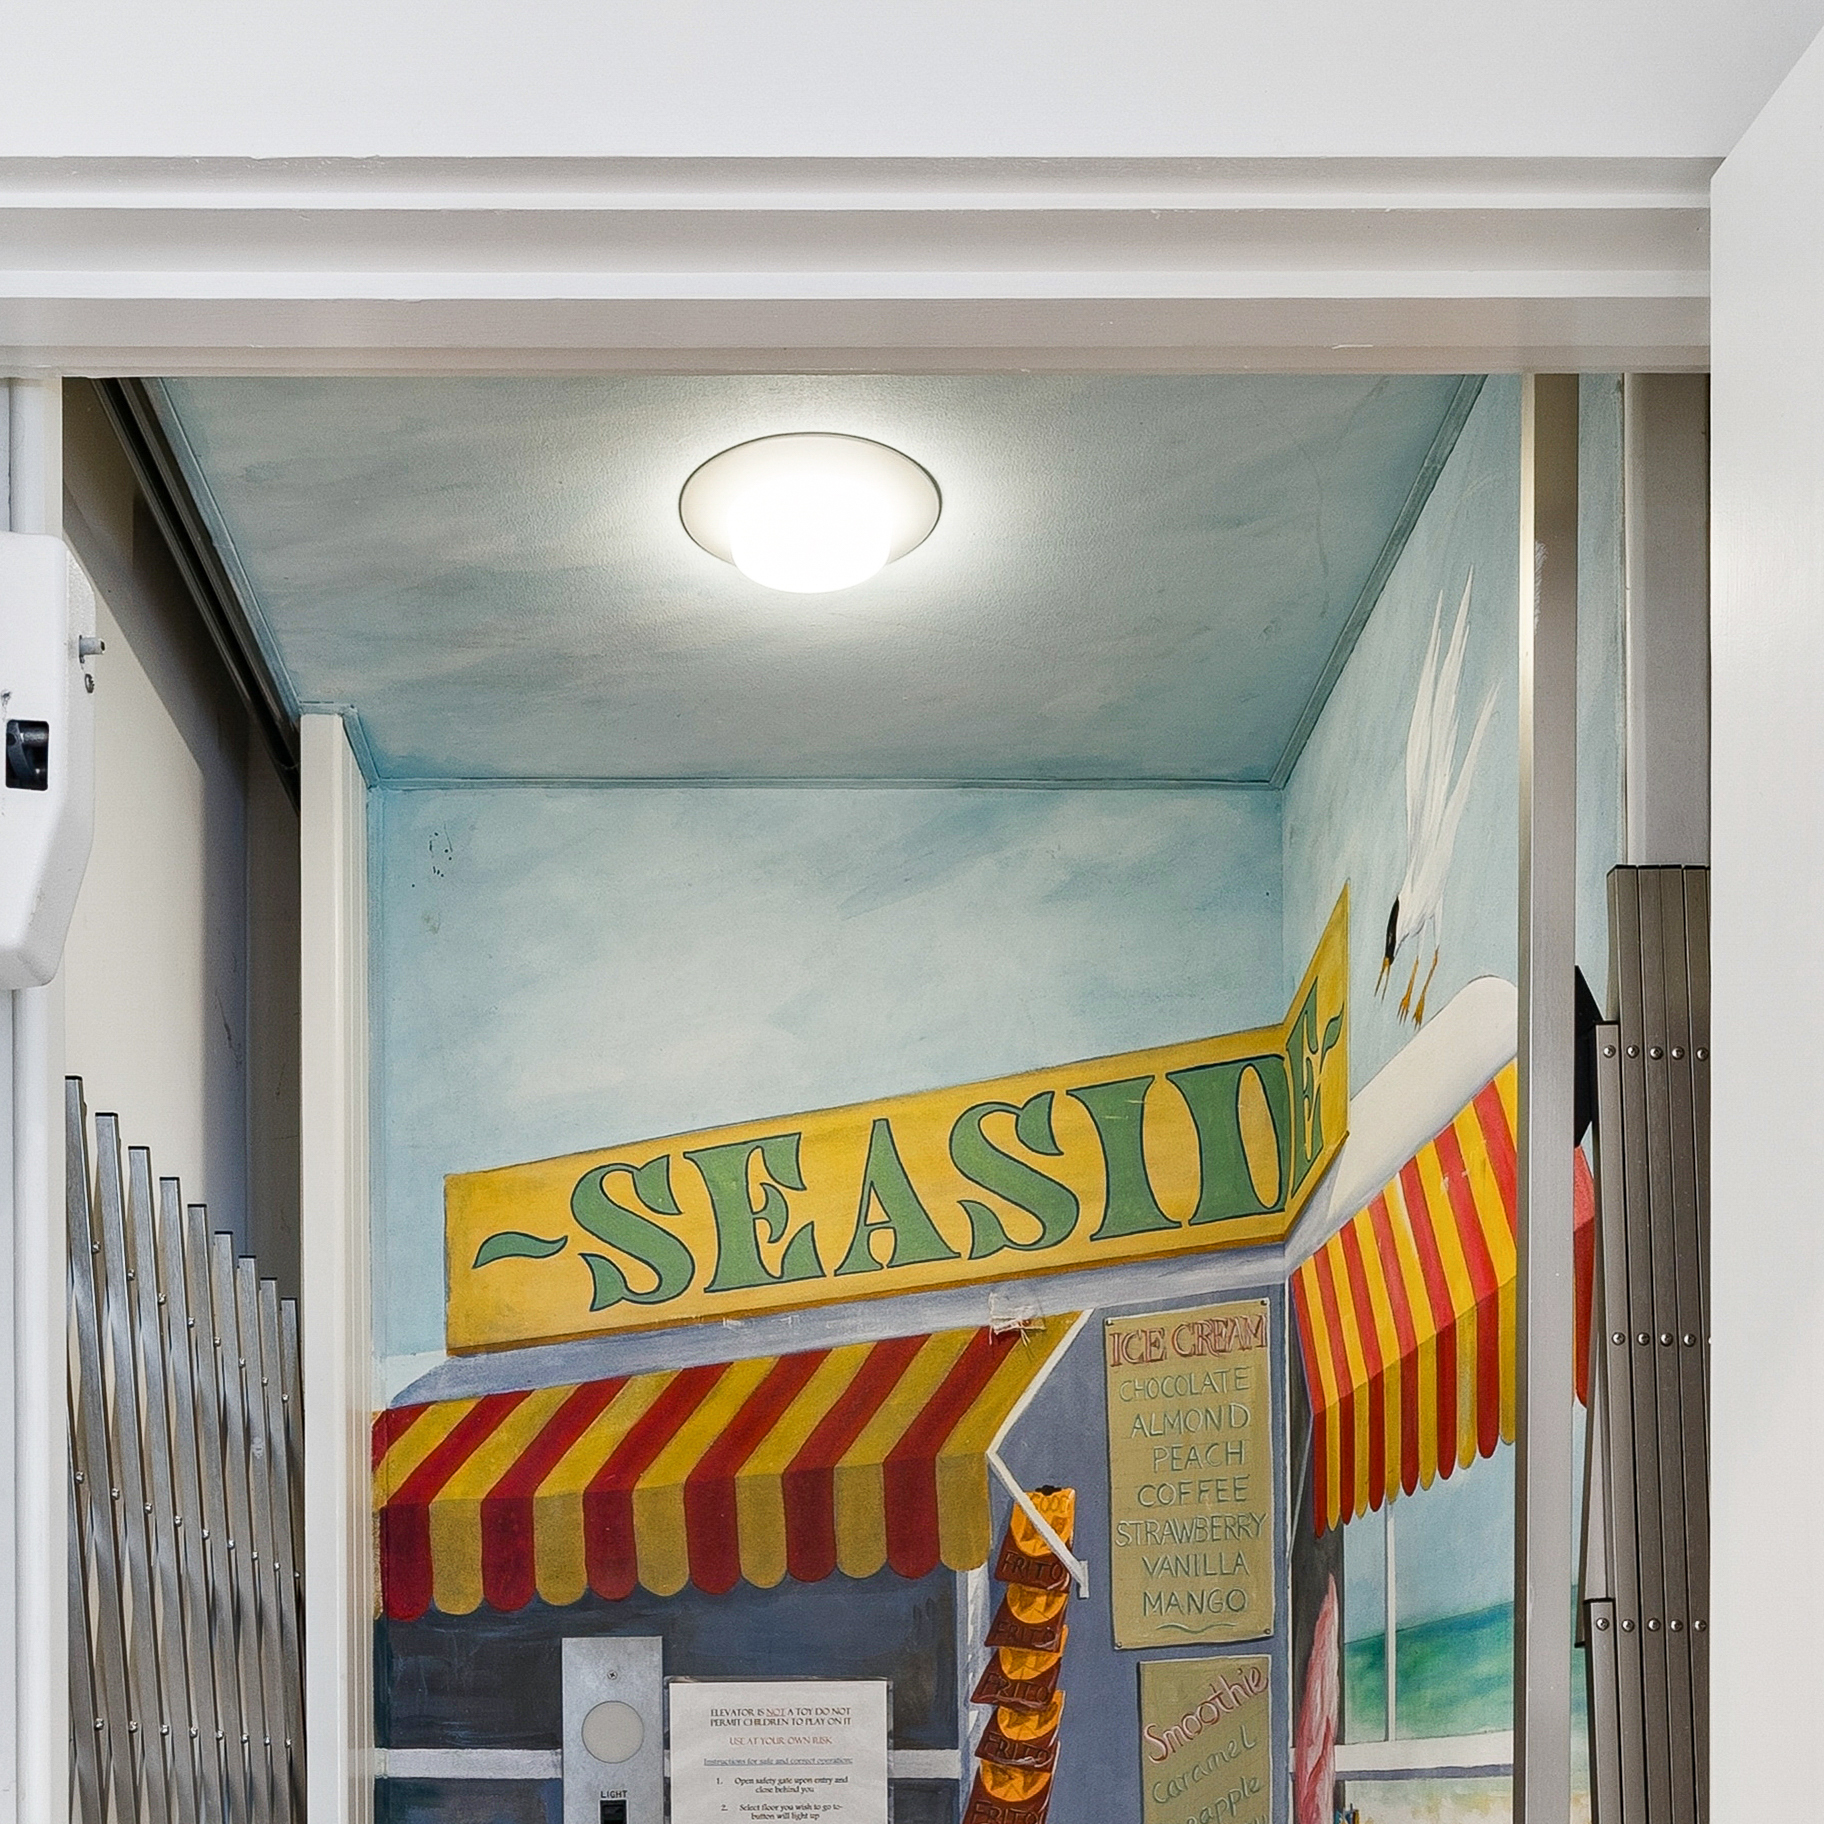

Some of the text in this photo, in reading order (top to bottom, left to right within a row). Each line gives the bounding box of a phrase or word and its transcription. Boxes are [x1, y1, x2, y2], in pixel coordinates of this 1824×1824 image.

[570, 976, 1324, 1312] SEASIDE
[1109, 1314, 1268, 1367] ICE CREAM
[1119, 1366, 1251, 1402] CHOCOLATE
[1131, 1403, 1250, 1439] ALMOND
[1153, 1440, 1245, 1473] PEACH
[1137, 1474, 1250, 1507] COFFEE
[1115, 1512, 1269, 1547] STRAWBERRY
[1142, 1551, 1249, 1579] VANILLA
[1143, 1588, 1248, 1617] MANGO
[710, 1718, 740, 1726] PERMIT
[743, 1718, 789, 1726] CHILDREN
[792, 1718, 803, 1726] TO
[805, 1718, 825, 1726] PLAY
[711, 1708, 754, 1716] ELEVATOR
[757, 1708, 764, 1716] IS
[766, 1708, 785, 1717] NOT
[1144, 1666, 1269, 1764] Smoothie
[729, 1737, 745, 1745] USE
[748, 1737, 758, 1745] AT
[760, 1737, 785, 1745] YOUR
[704, 1758, 746, 1766] Instructions
[600, 1790, 627, 1798] LIGHT
[756, 1777, 776, 1786] safety
